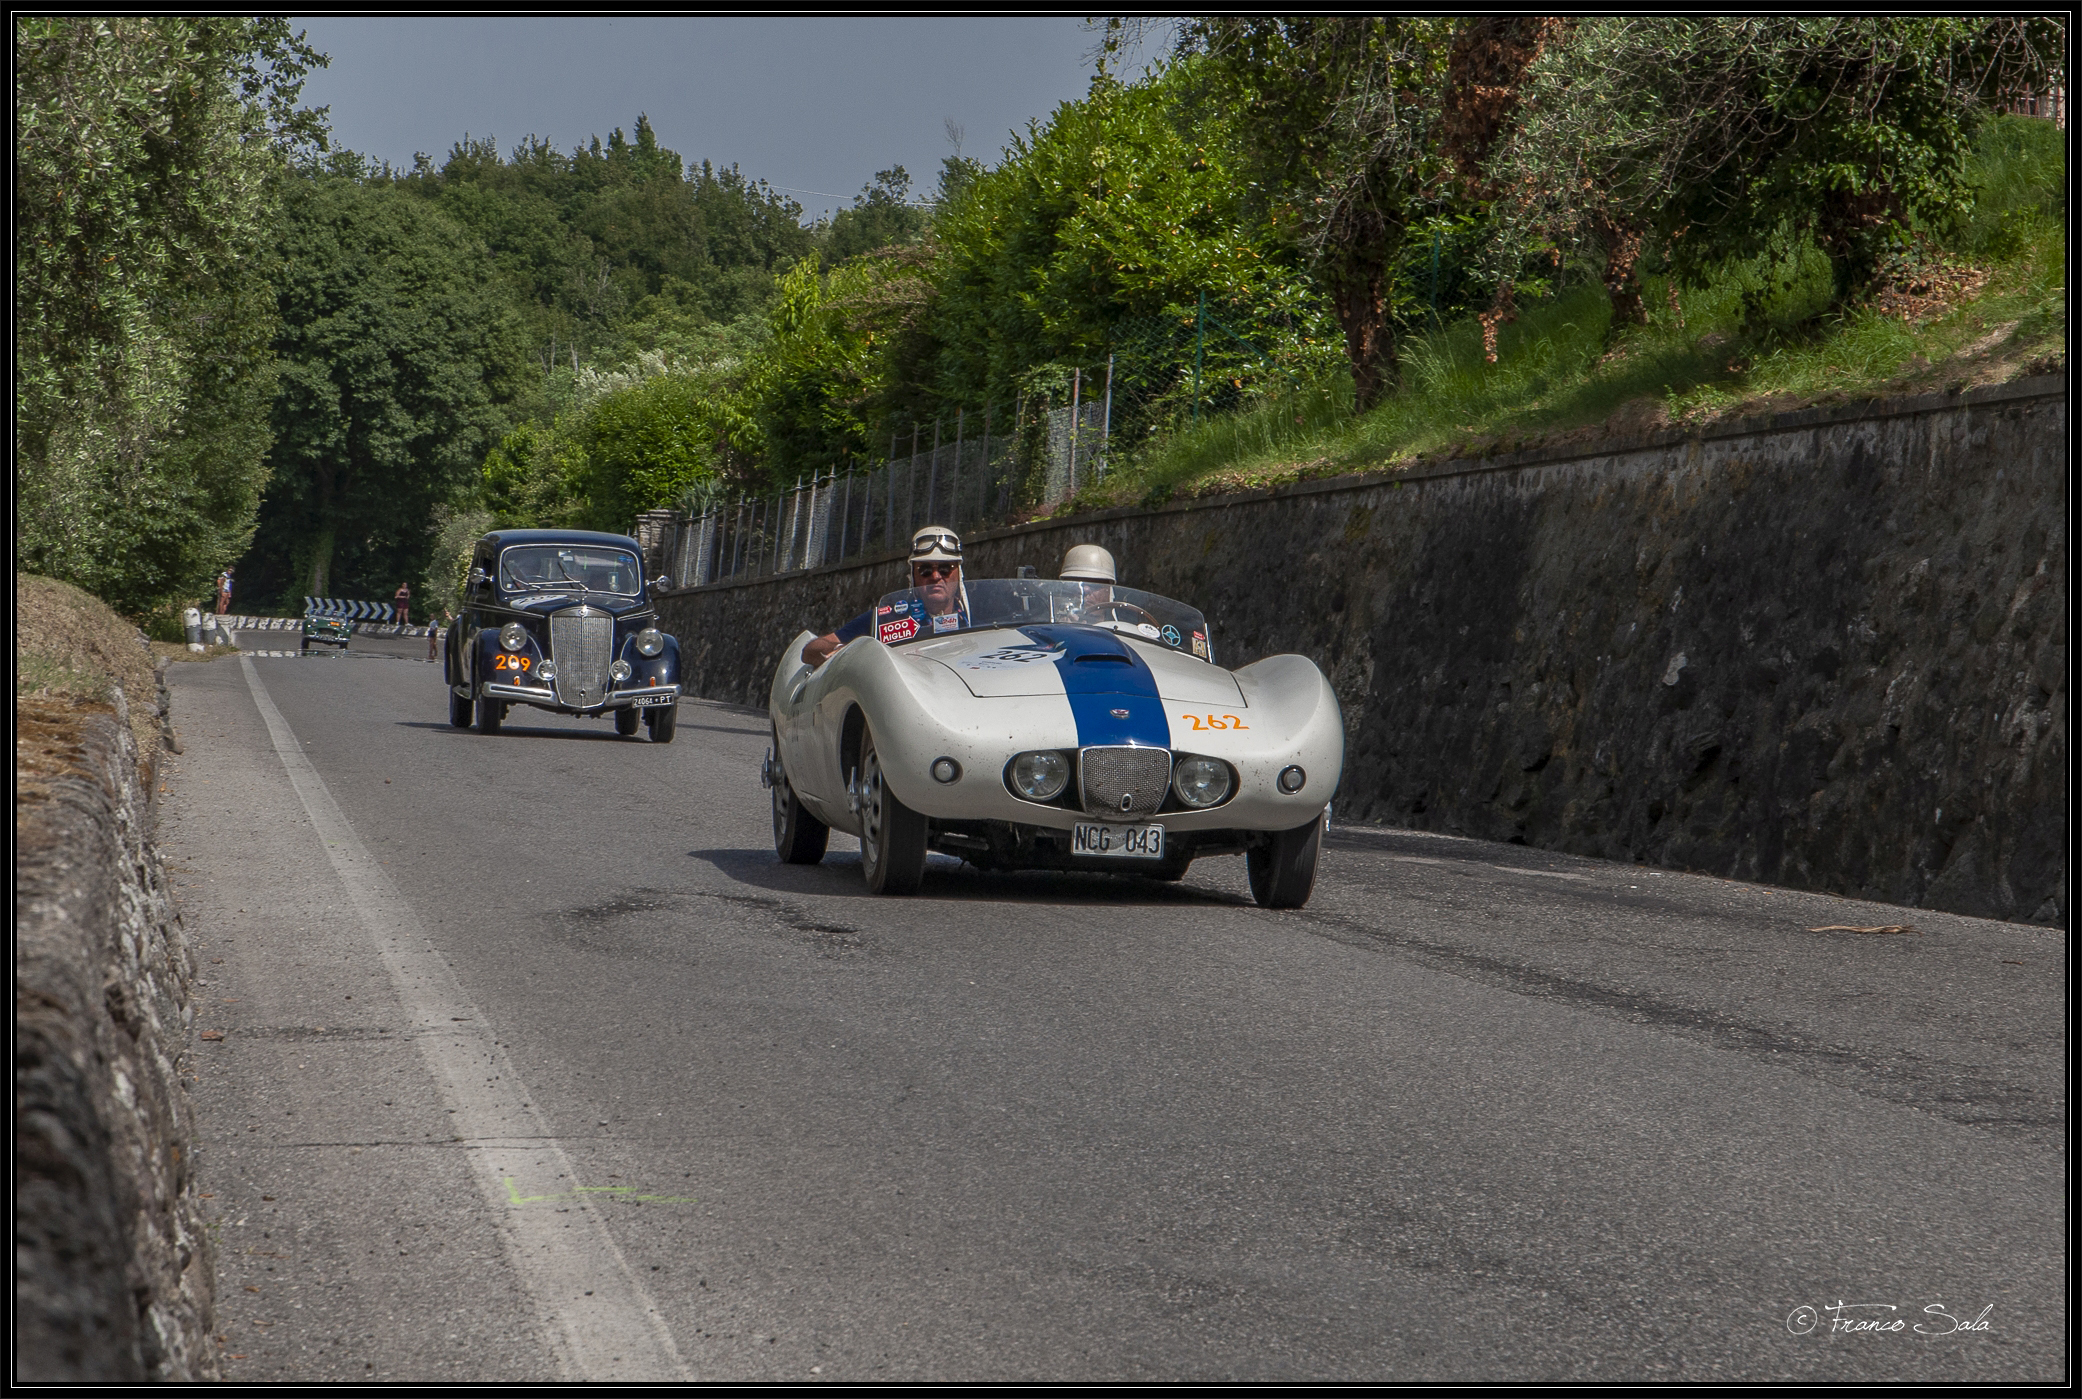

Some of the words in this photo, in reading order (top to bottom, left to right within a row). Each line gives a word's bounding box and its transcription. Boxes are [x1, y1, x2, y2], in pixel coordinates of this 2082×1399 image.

[883, 621, 909, 633] 1000
[882, 630, 912, 643] MIGLIA
[495, 654, 531, 672] 209
[979, 651, 1048, 663] 262
[660, 695, 671, 704] PT
[1182, 714, 1250, 731] 262
[1075, 825, 1110, 851] NCG
[1125, 828, 1160, 854] 043
